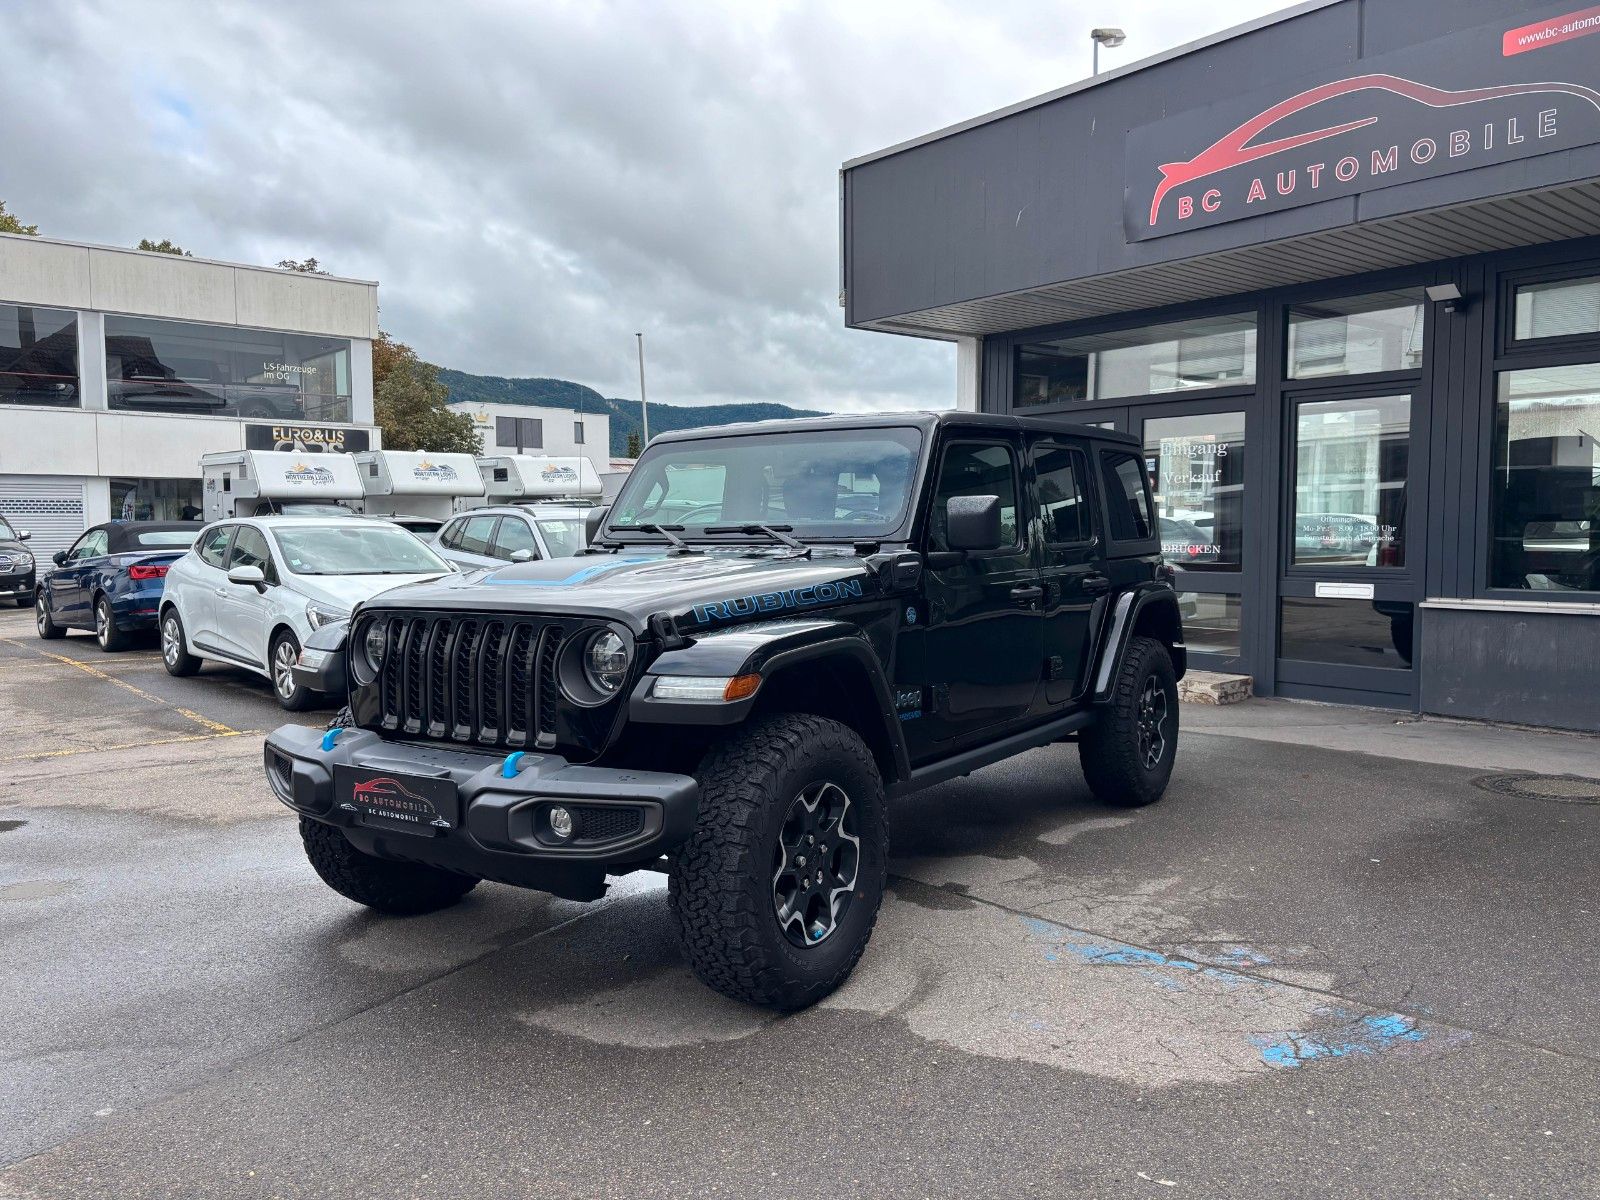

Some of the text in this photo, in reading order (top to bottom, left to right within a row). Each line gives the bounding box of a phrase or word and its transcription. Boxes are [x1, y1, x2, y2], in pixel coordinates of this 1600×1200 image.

[1178, 108, 1558, 220] BC AUTOMOBILE
[263, 362, 317, 375] US-Fahrzeuge
[276, 371, 290, 380] OG
[272, 426, 345, 443] EURO&US
[1160, 442, 1228, 458] Eingang
[1163, 469, 1222, 485] Verkauf
[1161, 541, 1221, 554] DRÜCKEN
[692, 579, 863, 623] RUBICON
[360, 794, 429, 813] BC AUTOMOBILE
[378, 811, 419, 822] AUTOMOBILE
